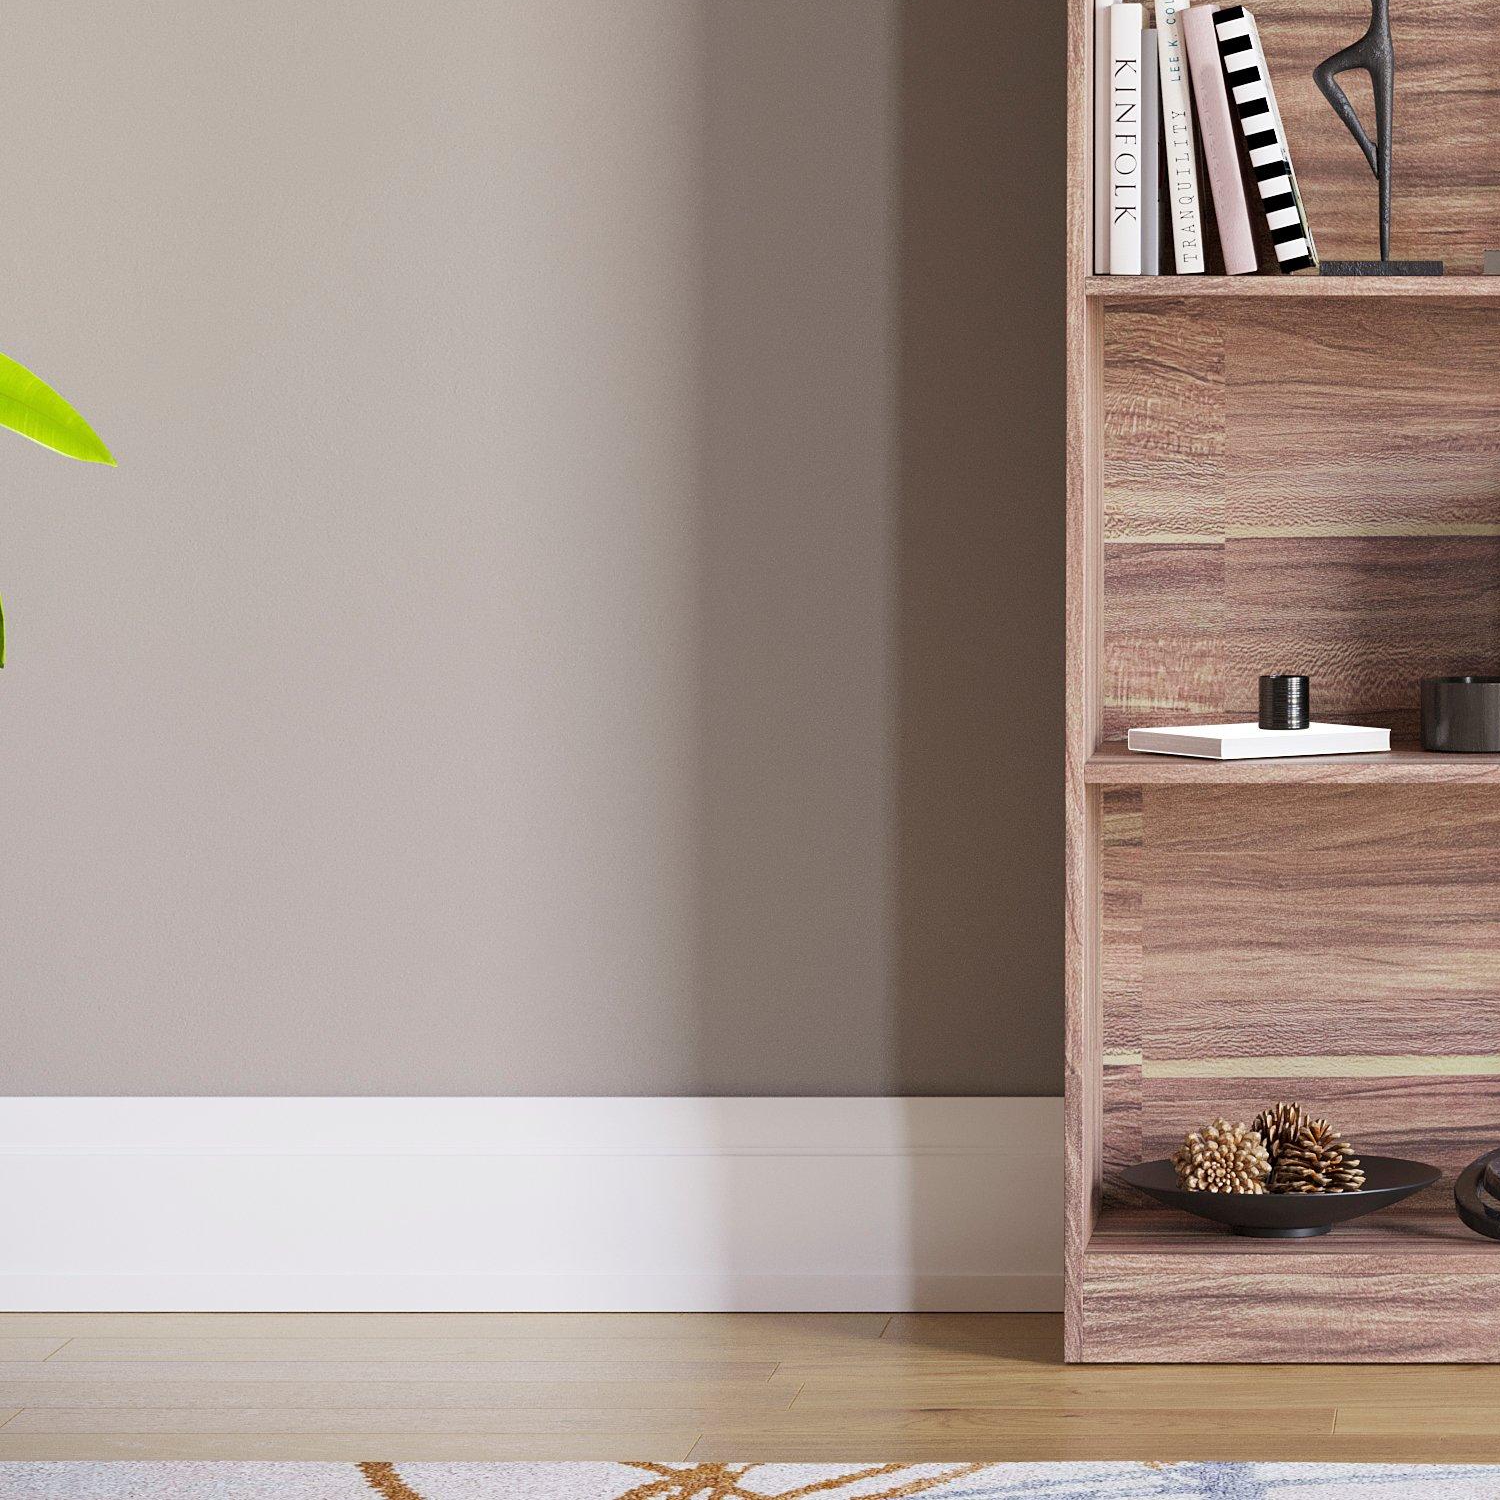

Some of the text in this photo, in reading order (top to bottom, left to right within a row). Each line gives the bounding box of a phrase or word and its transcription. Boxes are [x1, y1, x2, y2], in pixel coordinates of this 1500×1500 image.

[1114, 59, 1137, 224] KINFOLK
[1169, 56, 1181, 82] LEE
[1171, 110, 1198, 263] TRANQUILITY
